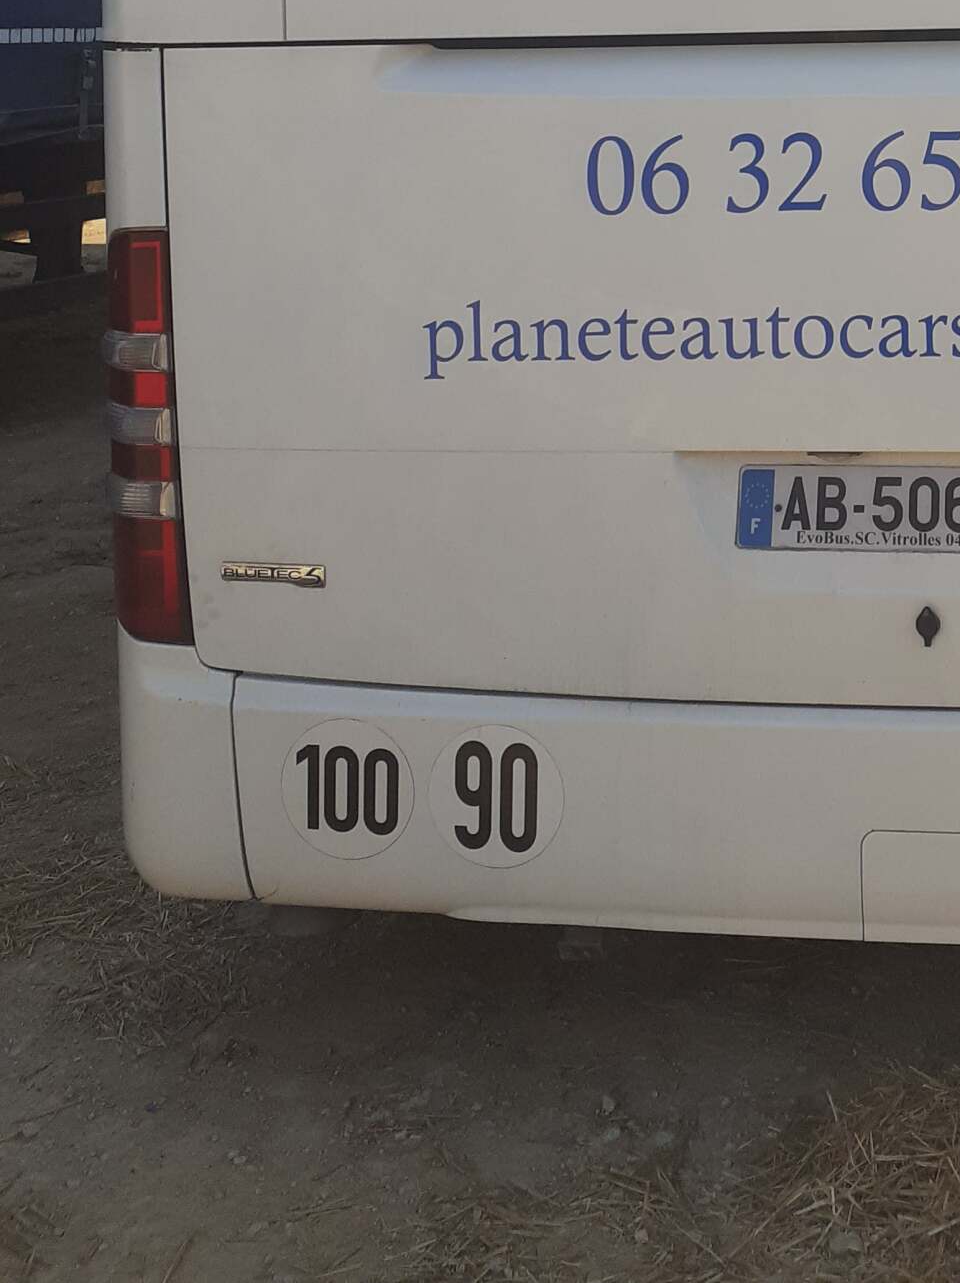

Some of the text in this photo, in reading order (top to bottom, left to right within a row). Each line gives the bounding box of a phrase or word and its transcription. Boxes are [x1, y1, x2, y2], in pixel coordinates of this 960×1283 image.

[586, 136, 689, 215] 06
[727, 133, 827, 213] 32
[750, 517, 761, 535] F
[295, 744, 400, 836] 100
[454, 740, 539, 854] 90
